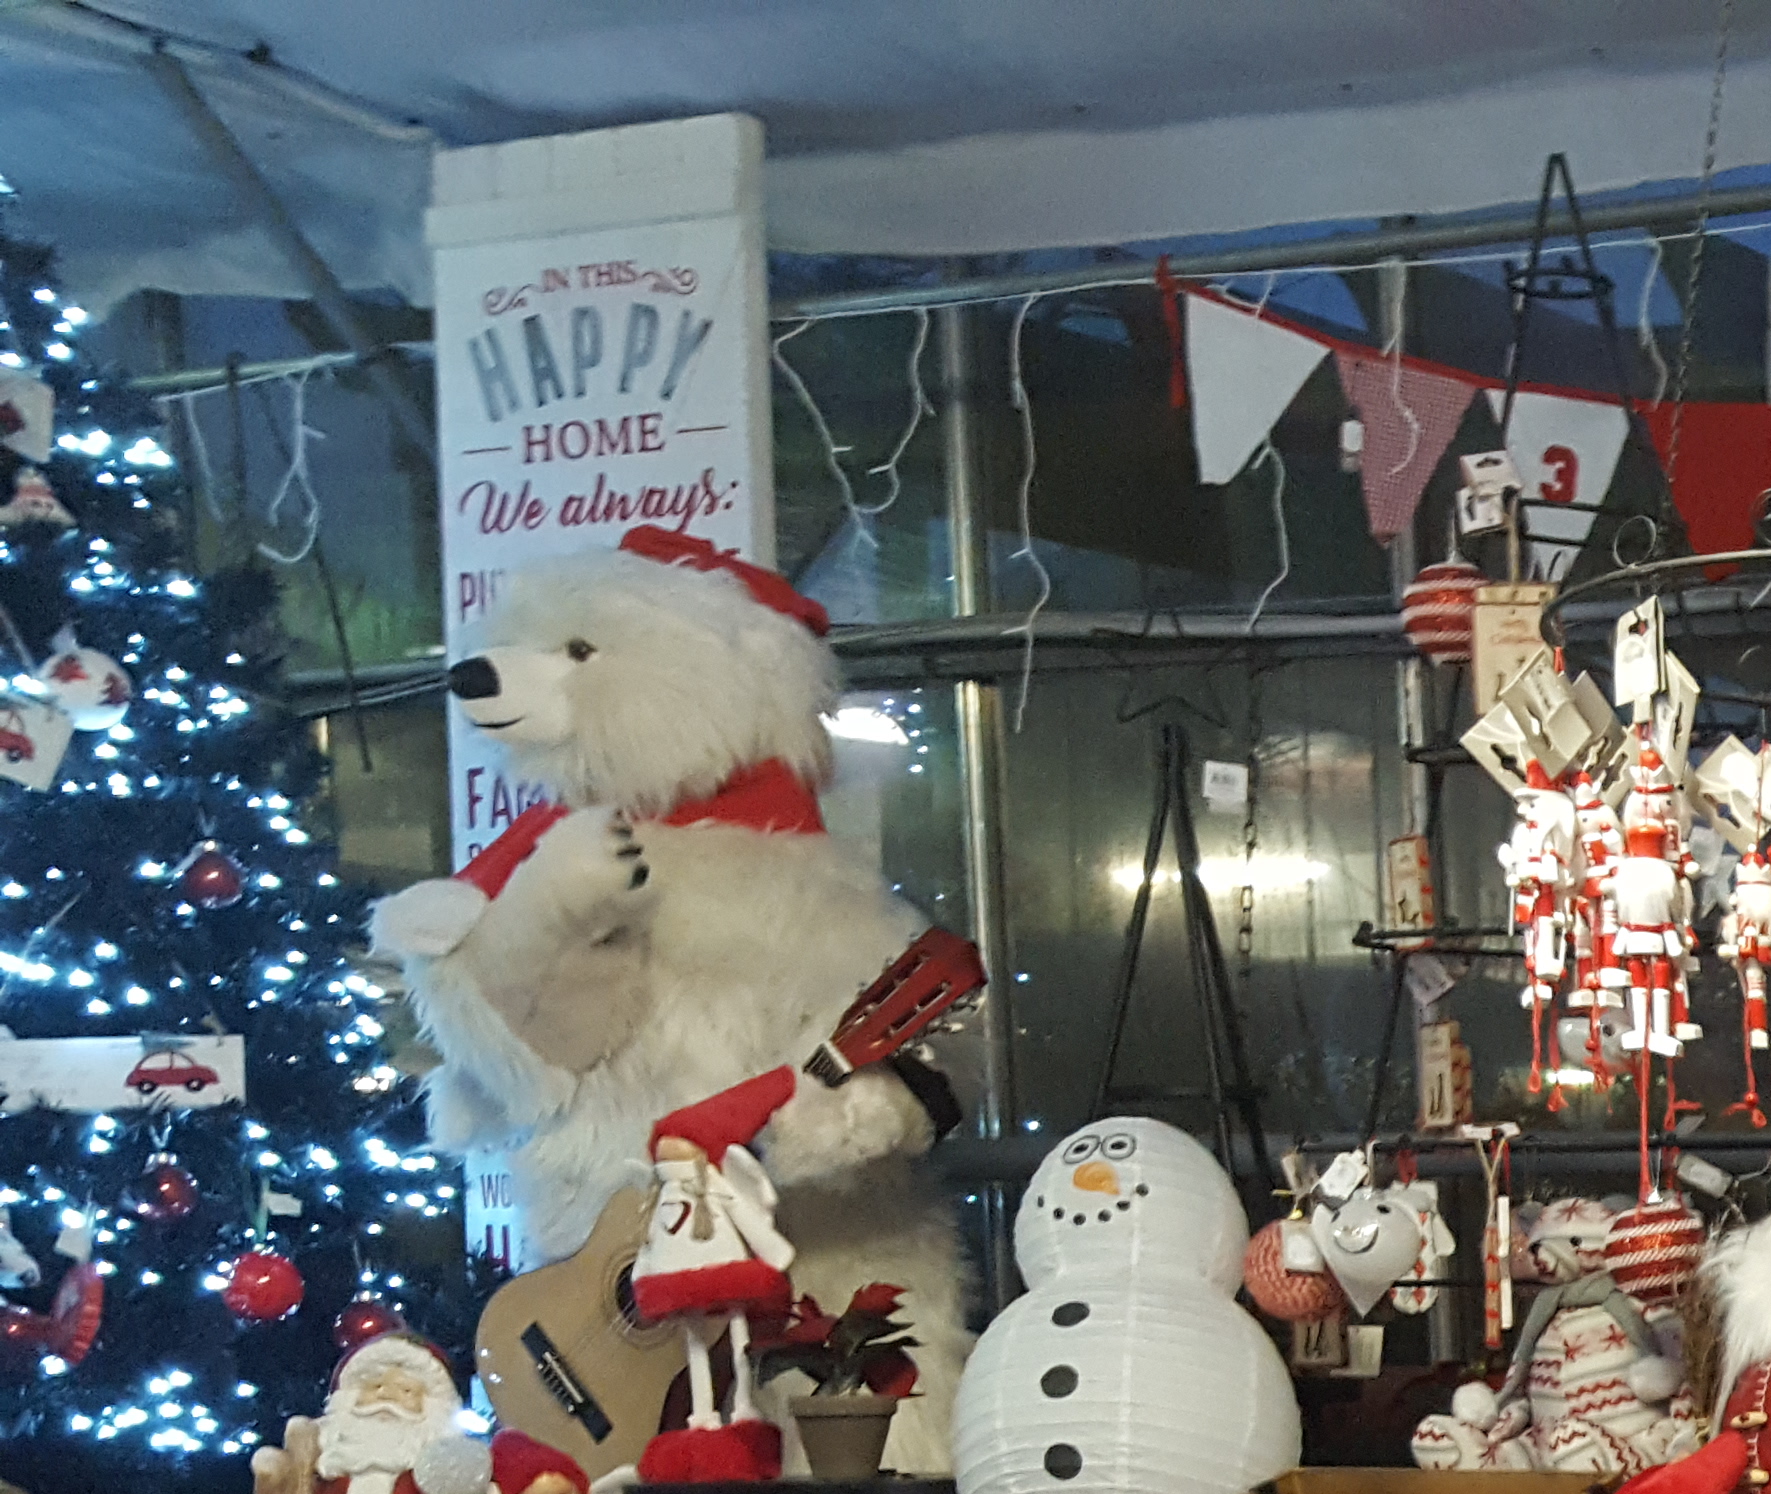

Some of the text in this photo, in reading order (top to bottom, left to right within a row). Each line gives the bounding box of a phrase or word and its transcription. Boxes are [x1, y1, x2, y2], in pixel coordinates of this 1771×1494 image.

[541, 259, 639, 292] IN THIS
[468, 302, 714, 422] HAPPY
[522, 413, 667, 465] HOME
[1539, 445, 1578, 503] 3
[457, 478, 552, 534] We
